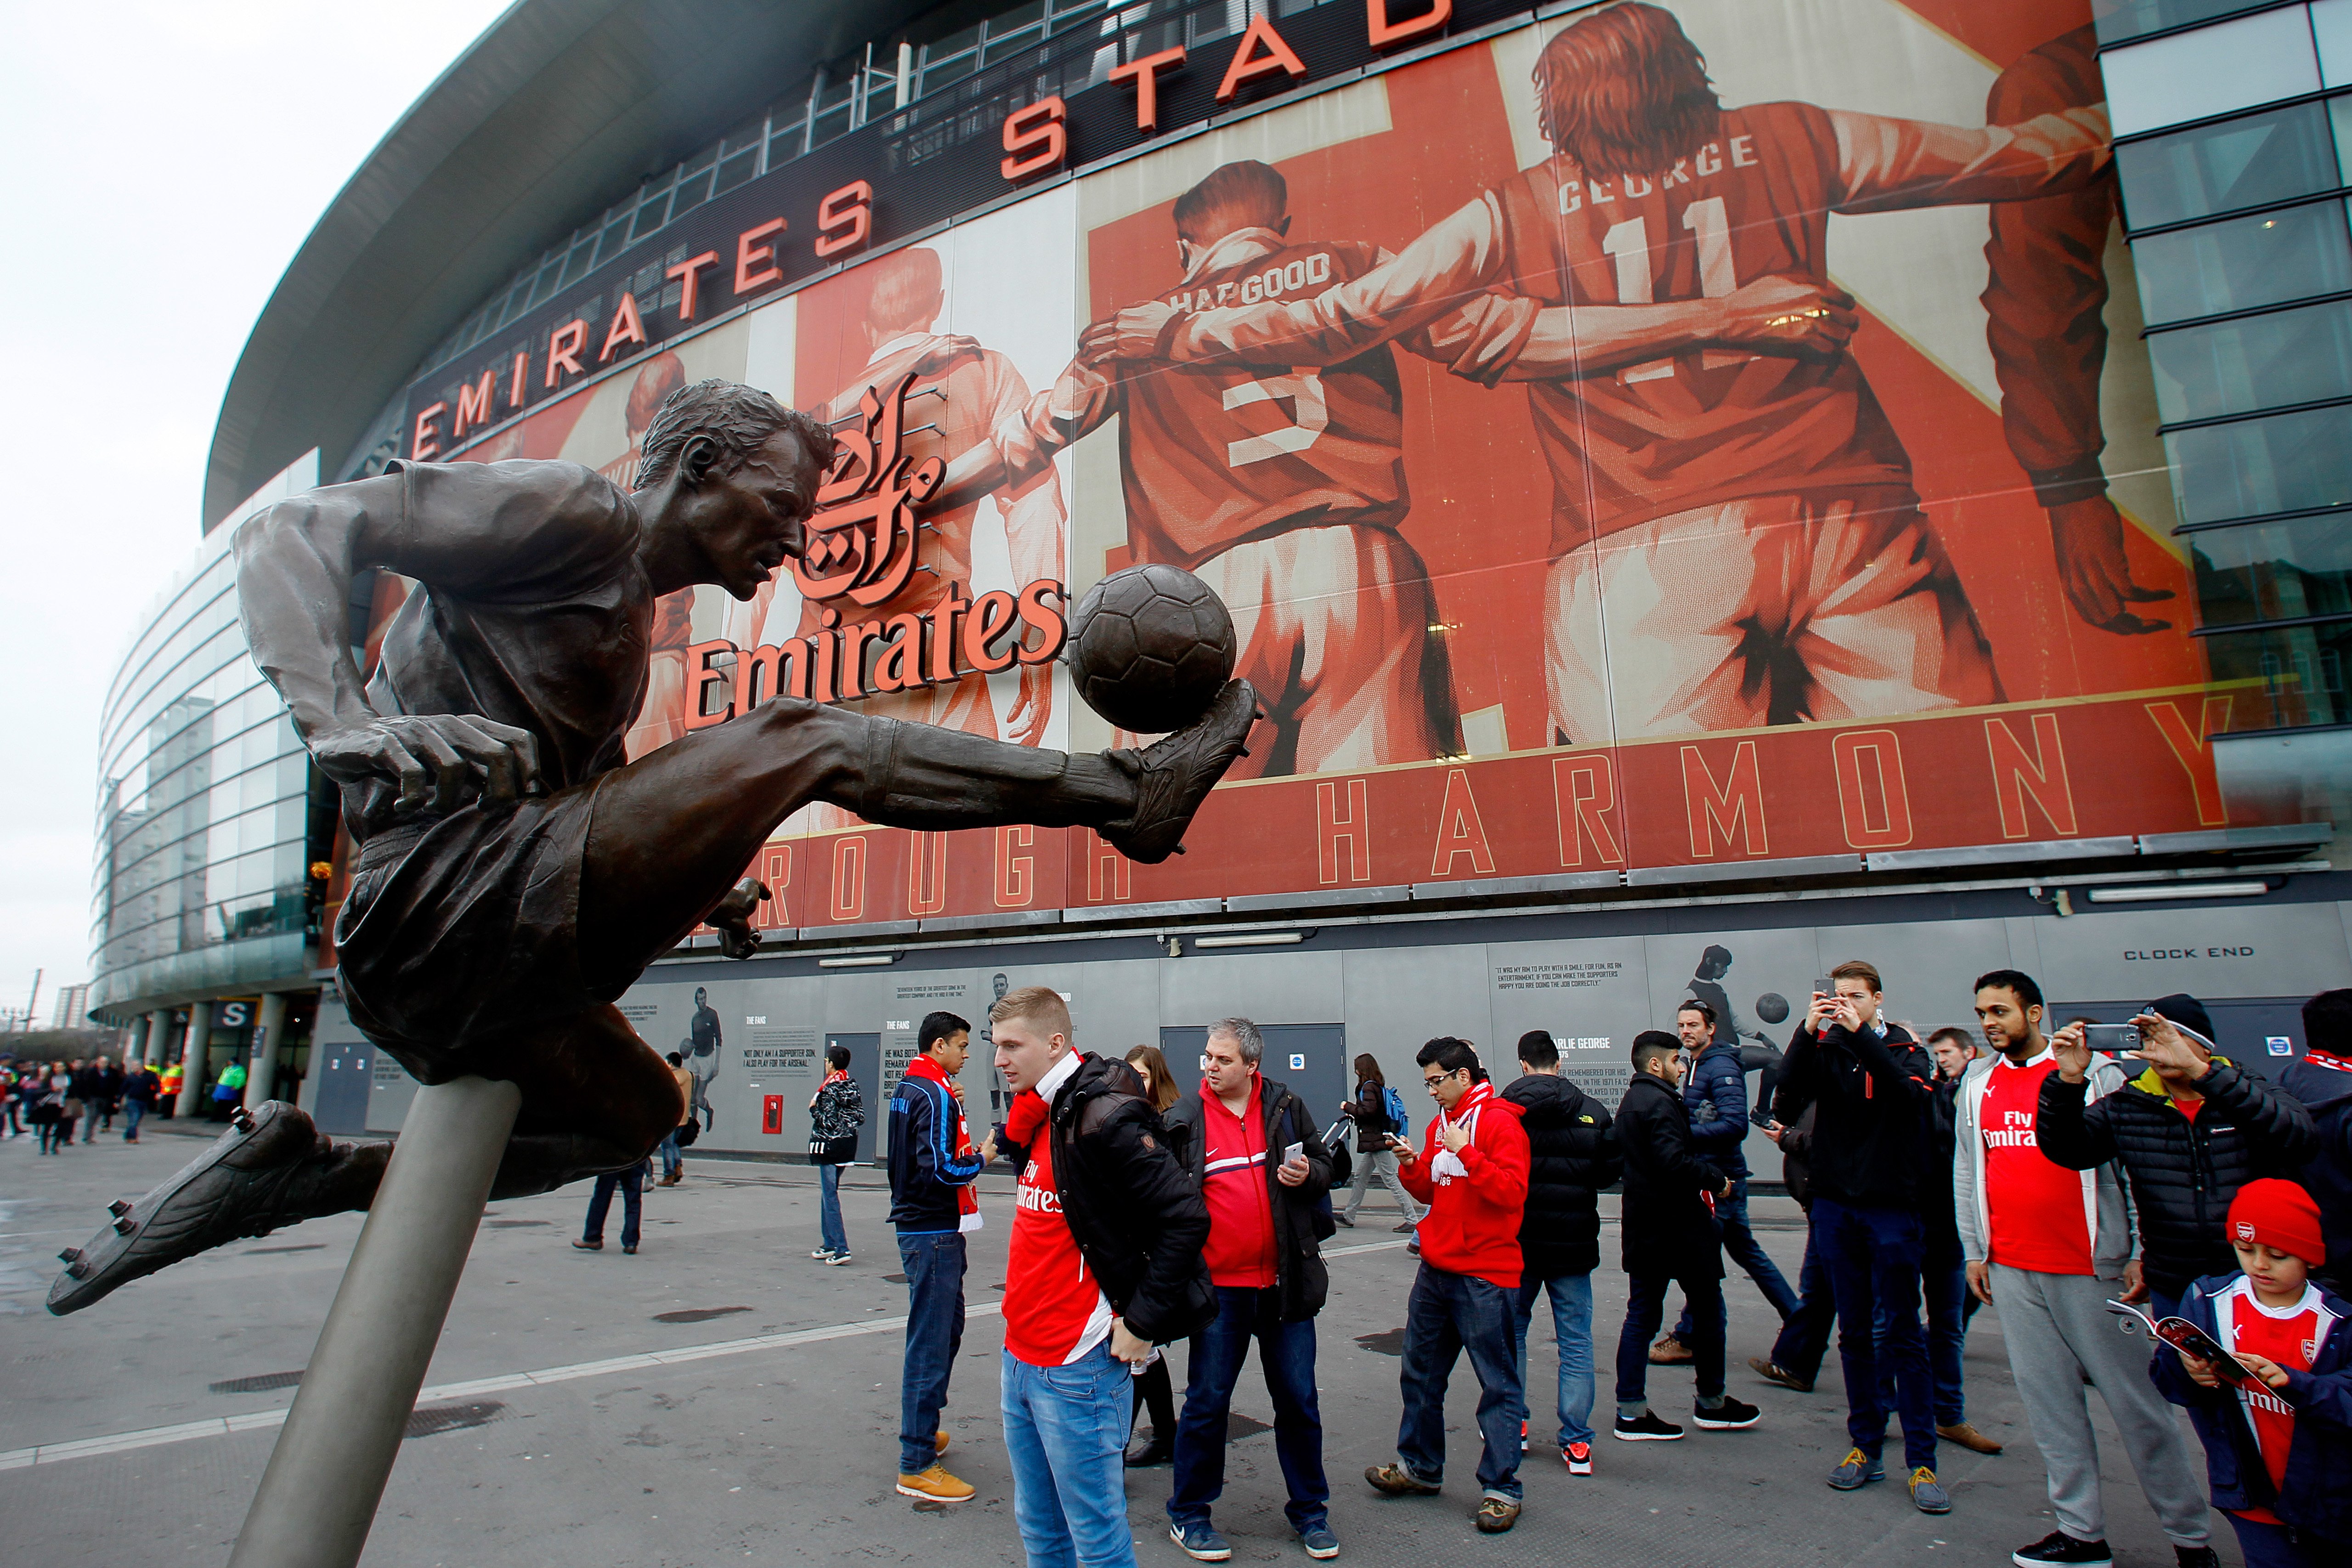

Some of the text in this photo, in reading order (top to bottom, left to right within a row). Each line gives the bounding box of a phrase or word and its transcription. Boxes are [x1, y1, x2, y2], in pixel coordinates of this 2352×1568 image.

[1559, 135, 1758, 215] GEORGE
[411, 179, 872, 461] EMIRATES
[683, 578, 1069, 731] Emirates
[694, 695, 2233, 931] ROUGH HARMONY
[2124, 945, 2254, 961] CLOCK END
[221, 1002, 247, 1027] S
[746, 1016, 766, 1025] THE FANS
[887, 1020, 910, 1030] THE FANS
[1577, 1037, 1610, 1049] GEORGE
[886, 1049, 918, 1058] HE WAS BOTH
[885, 1070, 894, 1079] NOT
[884, 1081, 898, 1089] BRUT
[2004, 1110, 2032, 1127] Fly
[1023, 1160, 1039, 1183] Fly
